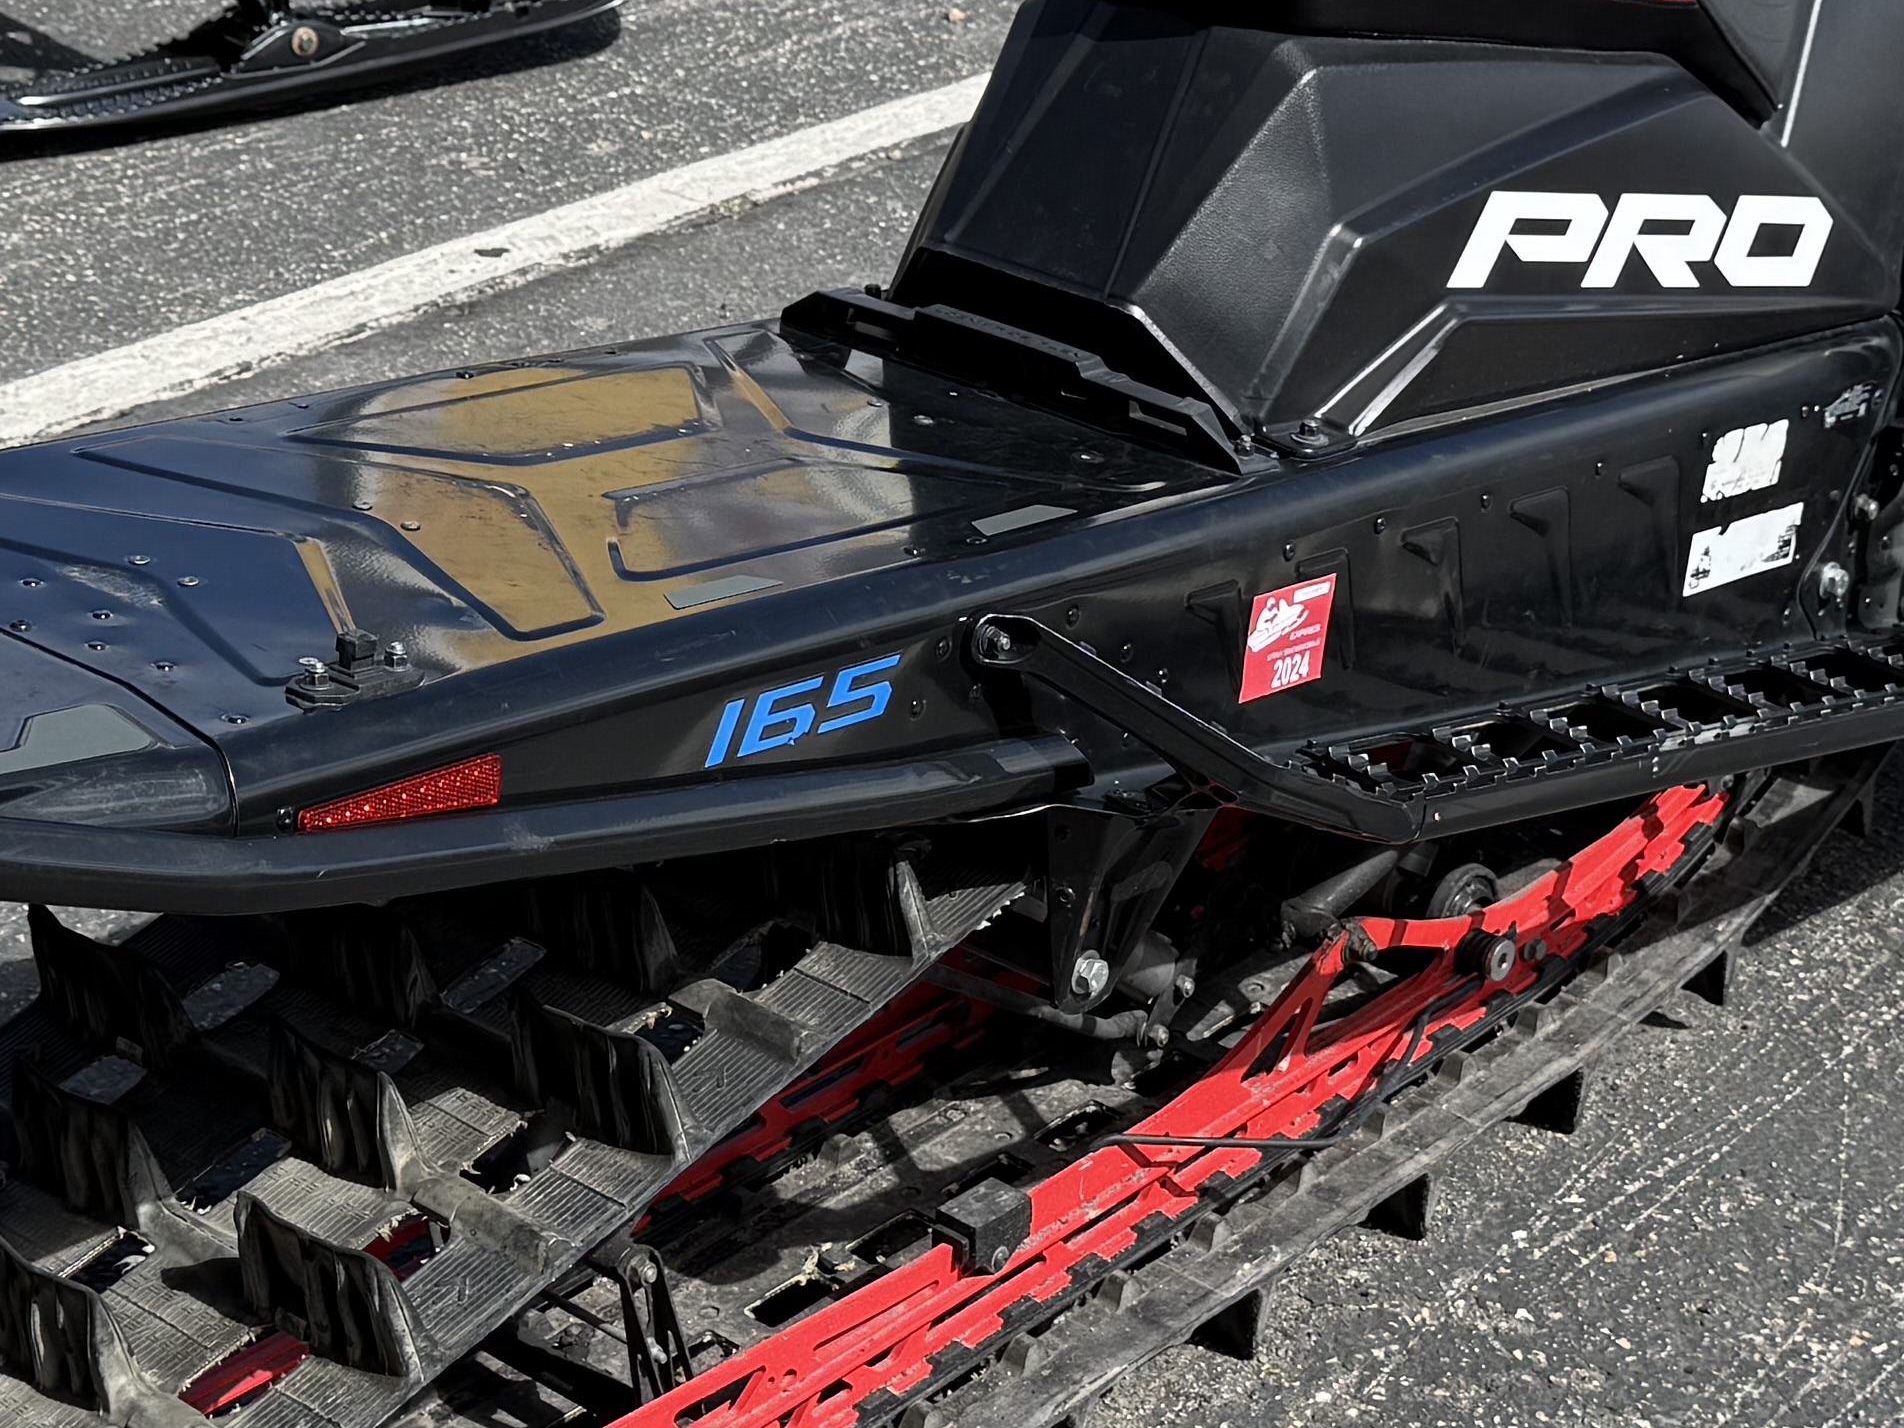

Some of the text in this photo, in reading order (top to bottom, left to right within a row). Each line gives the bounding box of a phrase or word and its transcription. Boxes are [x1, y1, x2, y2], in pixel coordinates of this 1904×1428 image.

[1446, 190, 1834, 289] PRO
[704, 652, 902, 768] 165
[1271, 651, 1310, 688] 2024
